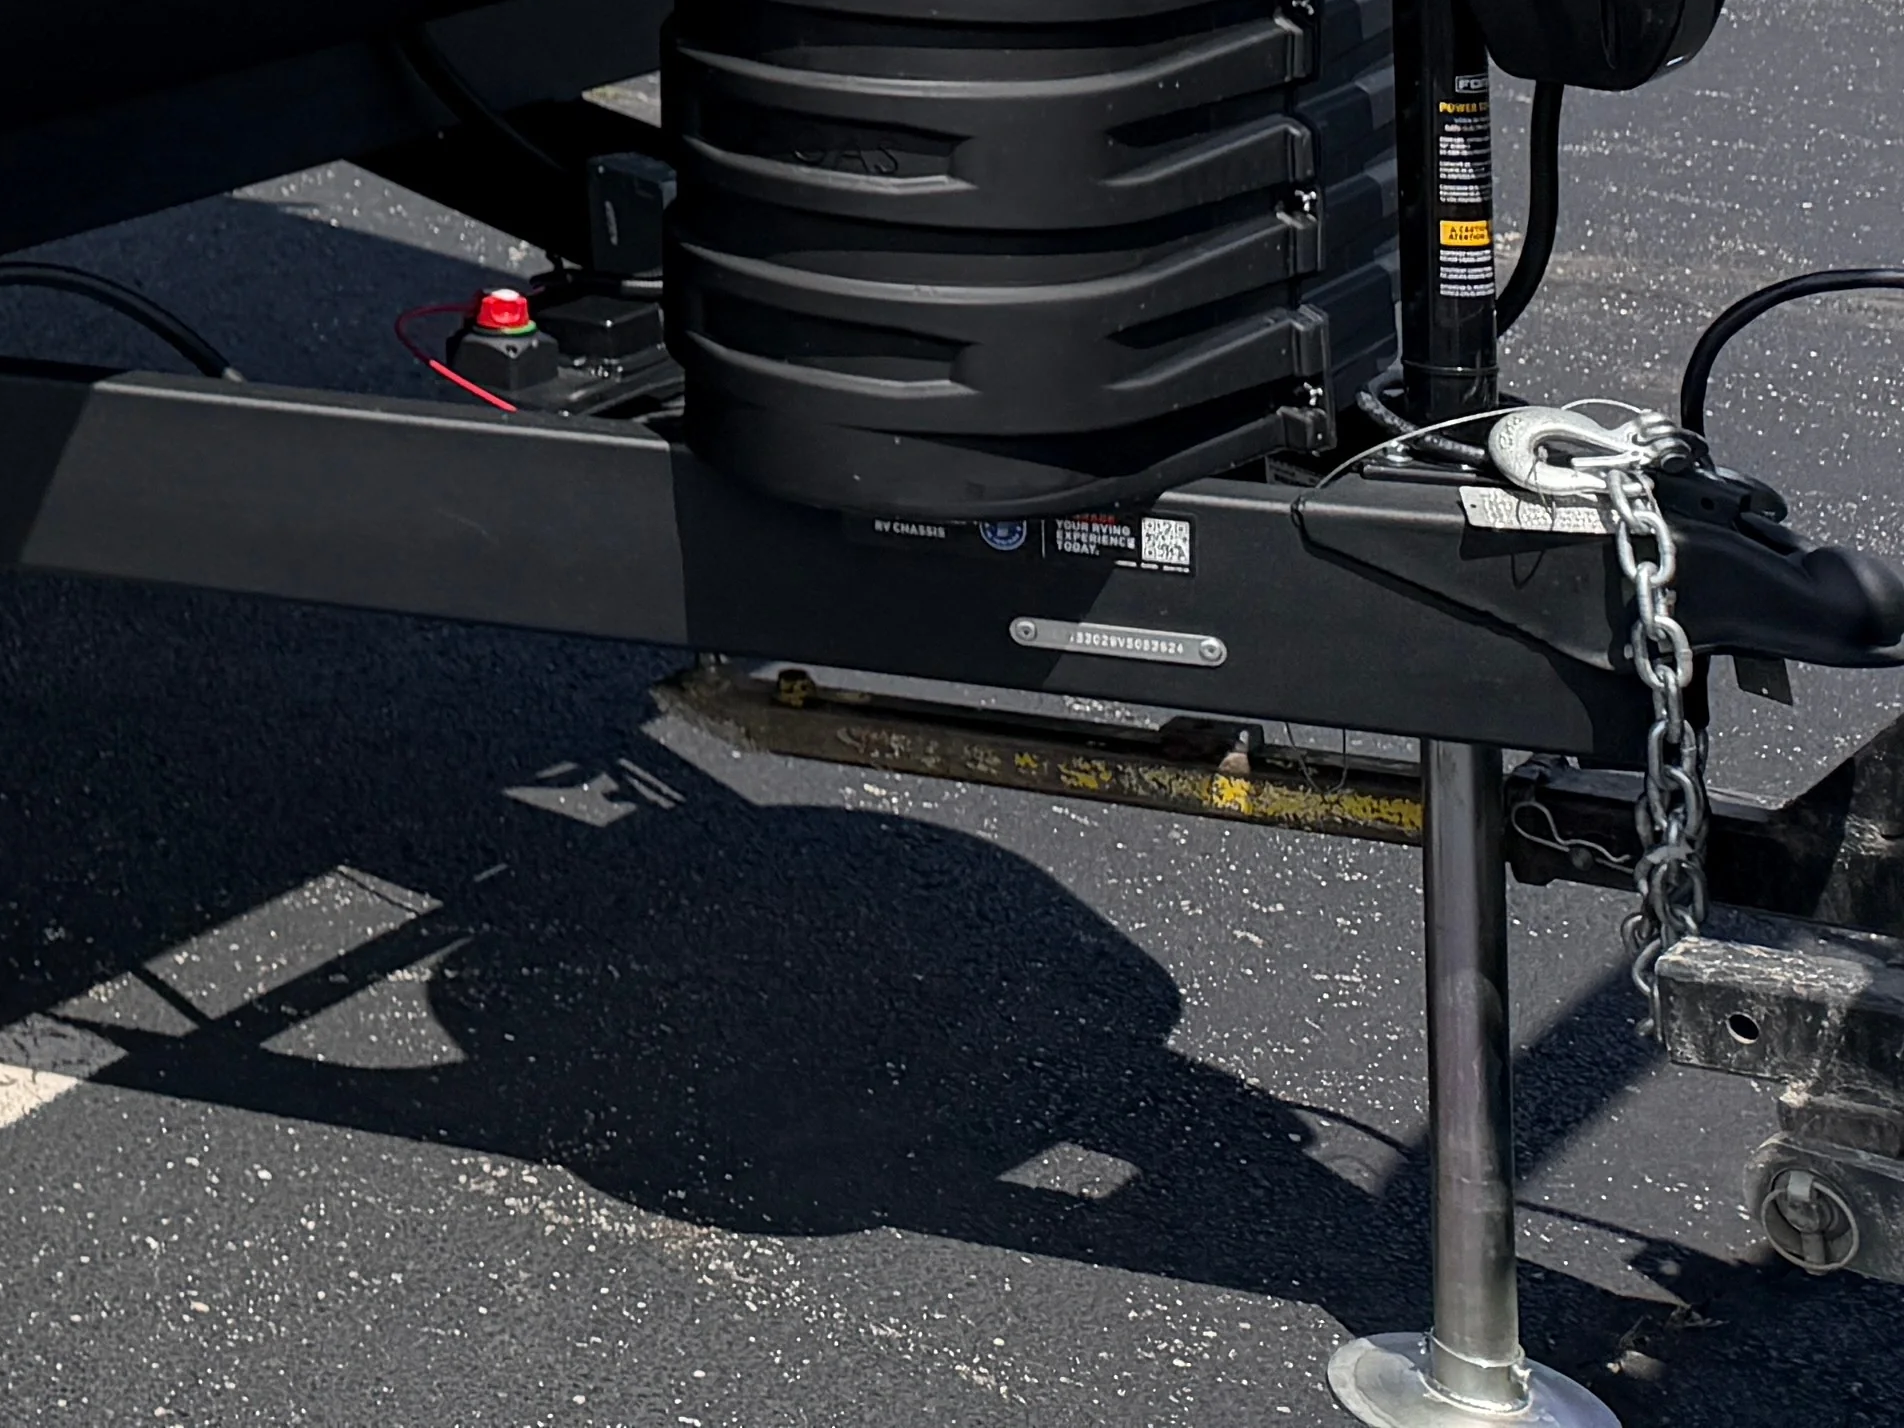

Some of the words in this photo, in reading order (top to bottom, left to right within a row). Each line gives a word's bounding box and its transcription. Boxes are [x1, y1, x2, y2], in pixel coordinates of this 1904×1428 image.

[892, 521, 946, 538] CHASSIS
[1055, 519, 1089, 531] YOUR
[1056, 529, 1135, 549] EXPERIENCE
